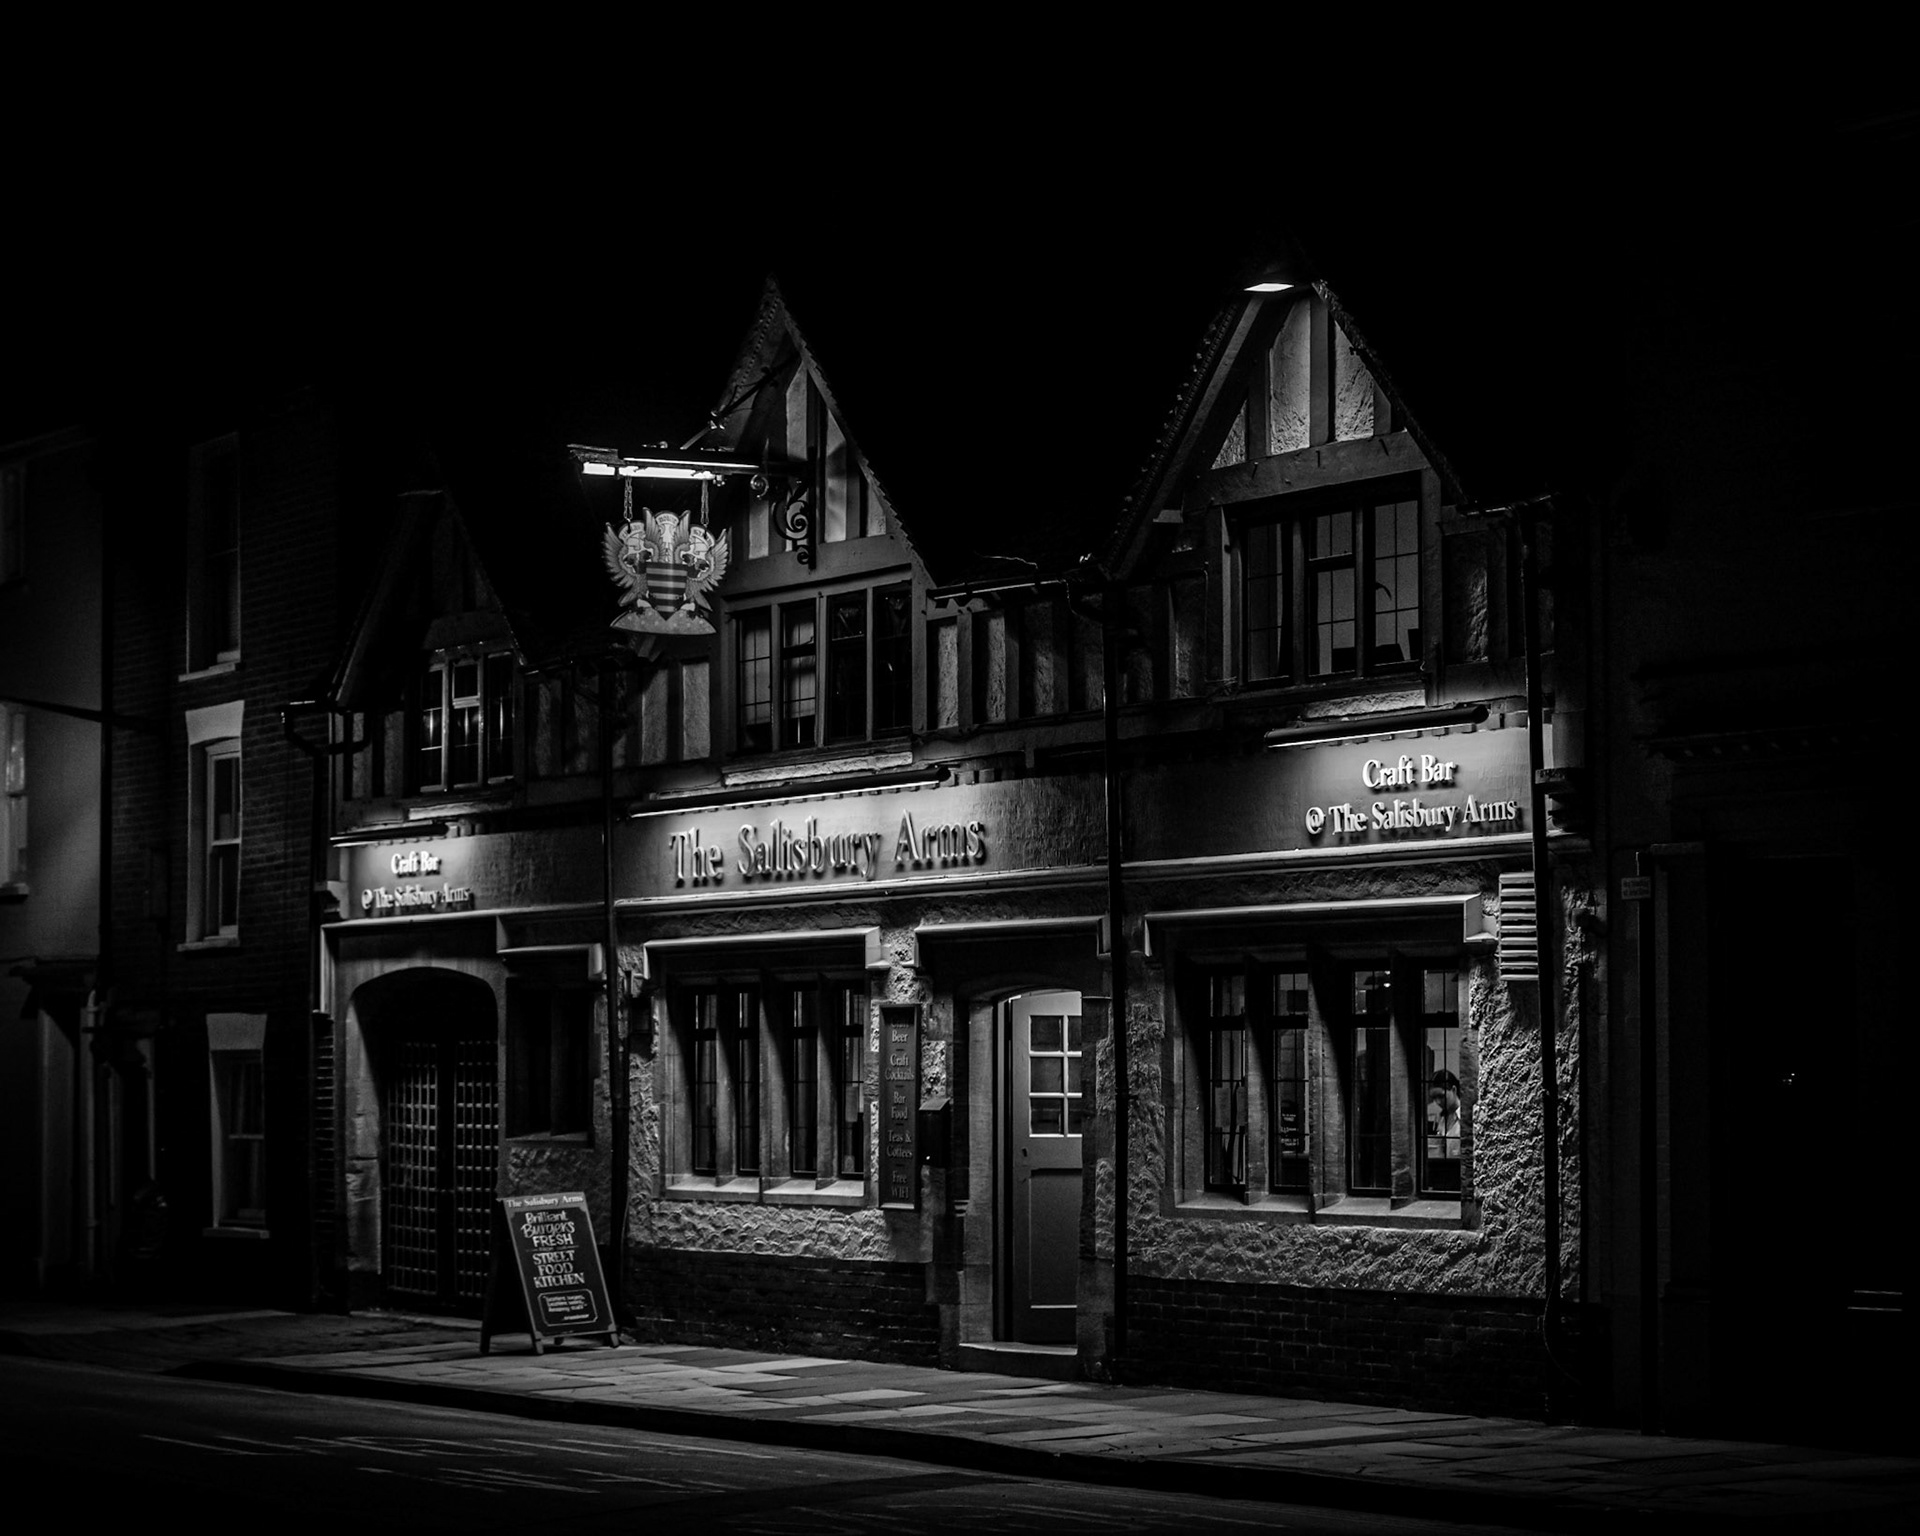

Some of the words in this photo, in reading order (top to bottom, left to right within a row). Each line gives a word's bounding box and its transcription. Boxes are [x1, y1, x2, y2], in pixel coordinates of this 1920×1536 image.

[1362, 755, 1416, 788] Craft
[1420, 754, 1457, 783] Bar
[1305, 806, 1326, 835] @
[1328, 803, 1367, 834] The
[1371, 798, 1456, 832] Salisbury
[1462, 794, 1518, 824] Arms
[669, 826, 724, 880] The
[737, 815, 881, 879] Salisbury
[893, 808, 985, 862] Arms
[390, 851, 418, 874] Craft
[420, 850, 440, 873] Bar
[361, 888, 373, 909] @
[373, 886, 394, 908] The
[394, 883, 438, 909] Salisbury
[441, 882, 471, 903] Arms
[891, 1029, 909, 1043] Beer
[890, 1054, 909, 1067] Craft
[885, 1068, 914, 1081] Cocktails
[893, 1092, 907, 1105] Bar
[891, 1107, 908, 1120] Food
[888, 1130, 904, 1143] Teas
[905, 1131, 912, 1143] &
[886, 1145, 913, 1159] Coffees
[892, 1171, 908, 1184] Free
[506, 1199, 522, 1208] The
[523, 1197, 559, 1207] Salisbury
[562, 1195, 583, 1204] Arms
[525, 1210, 568, 1225] Brilliant
[521, 1221, 576, 1238] Burgers
[532, 1234, 574, 1247] FRESH
[532, 1250, 575, 1265] STREET
[537, 1262, 573, 1276] FOOD
[533, 1272, 585, 1288] KITCHEN
